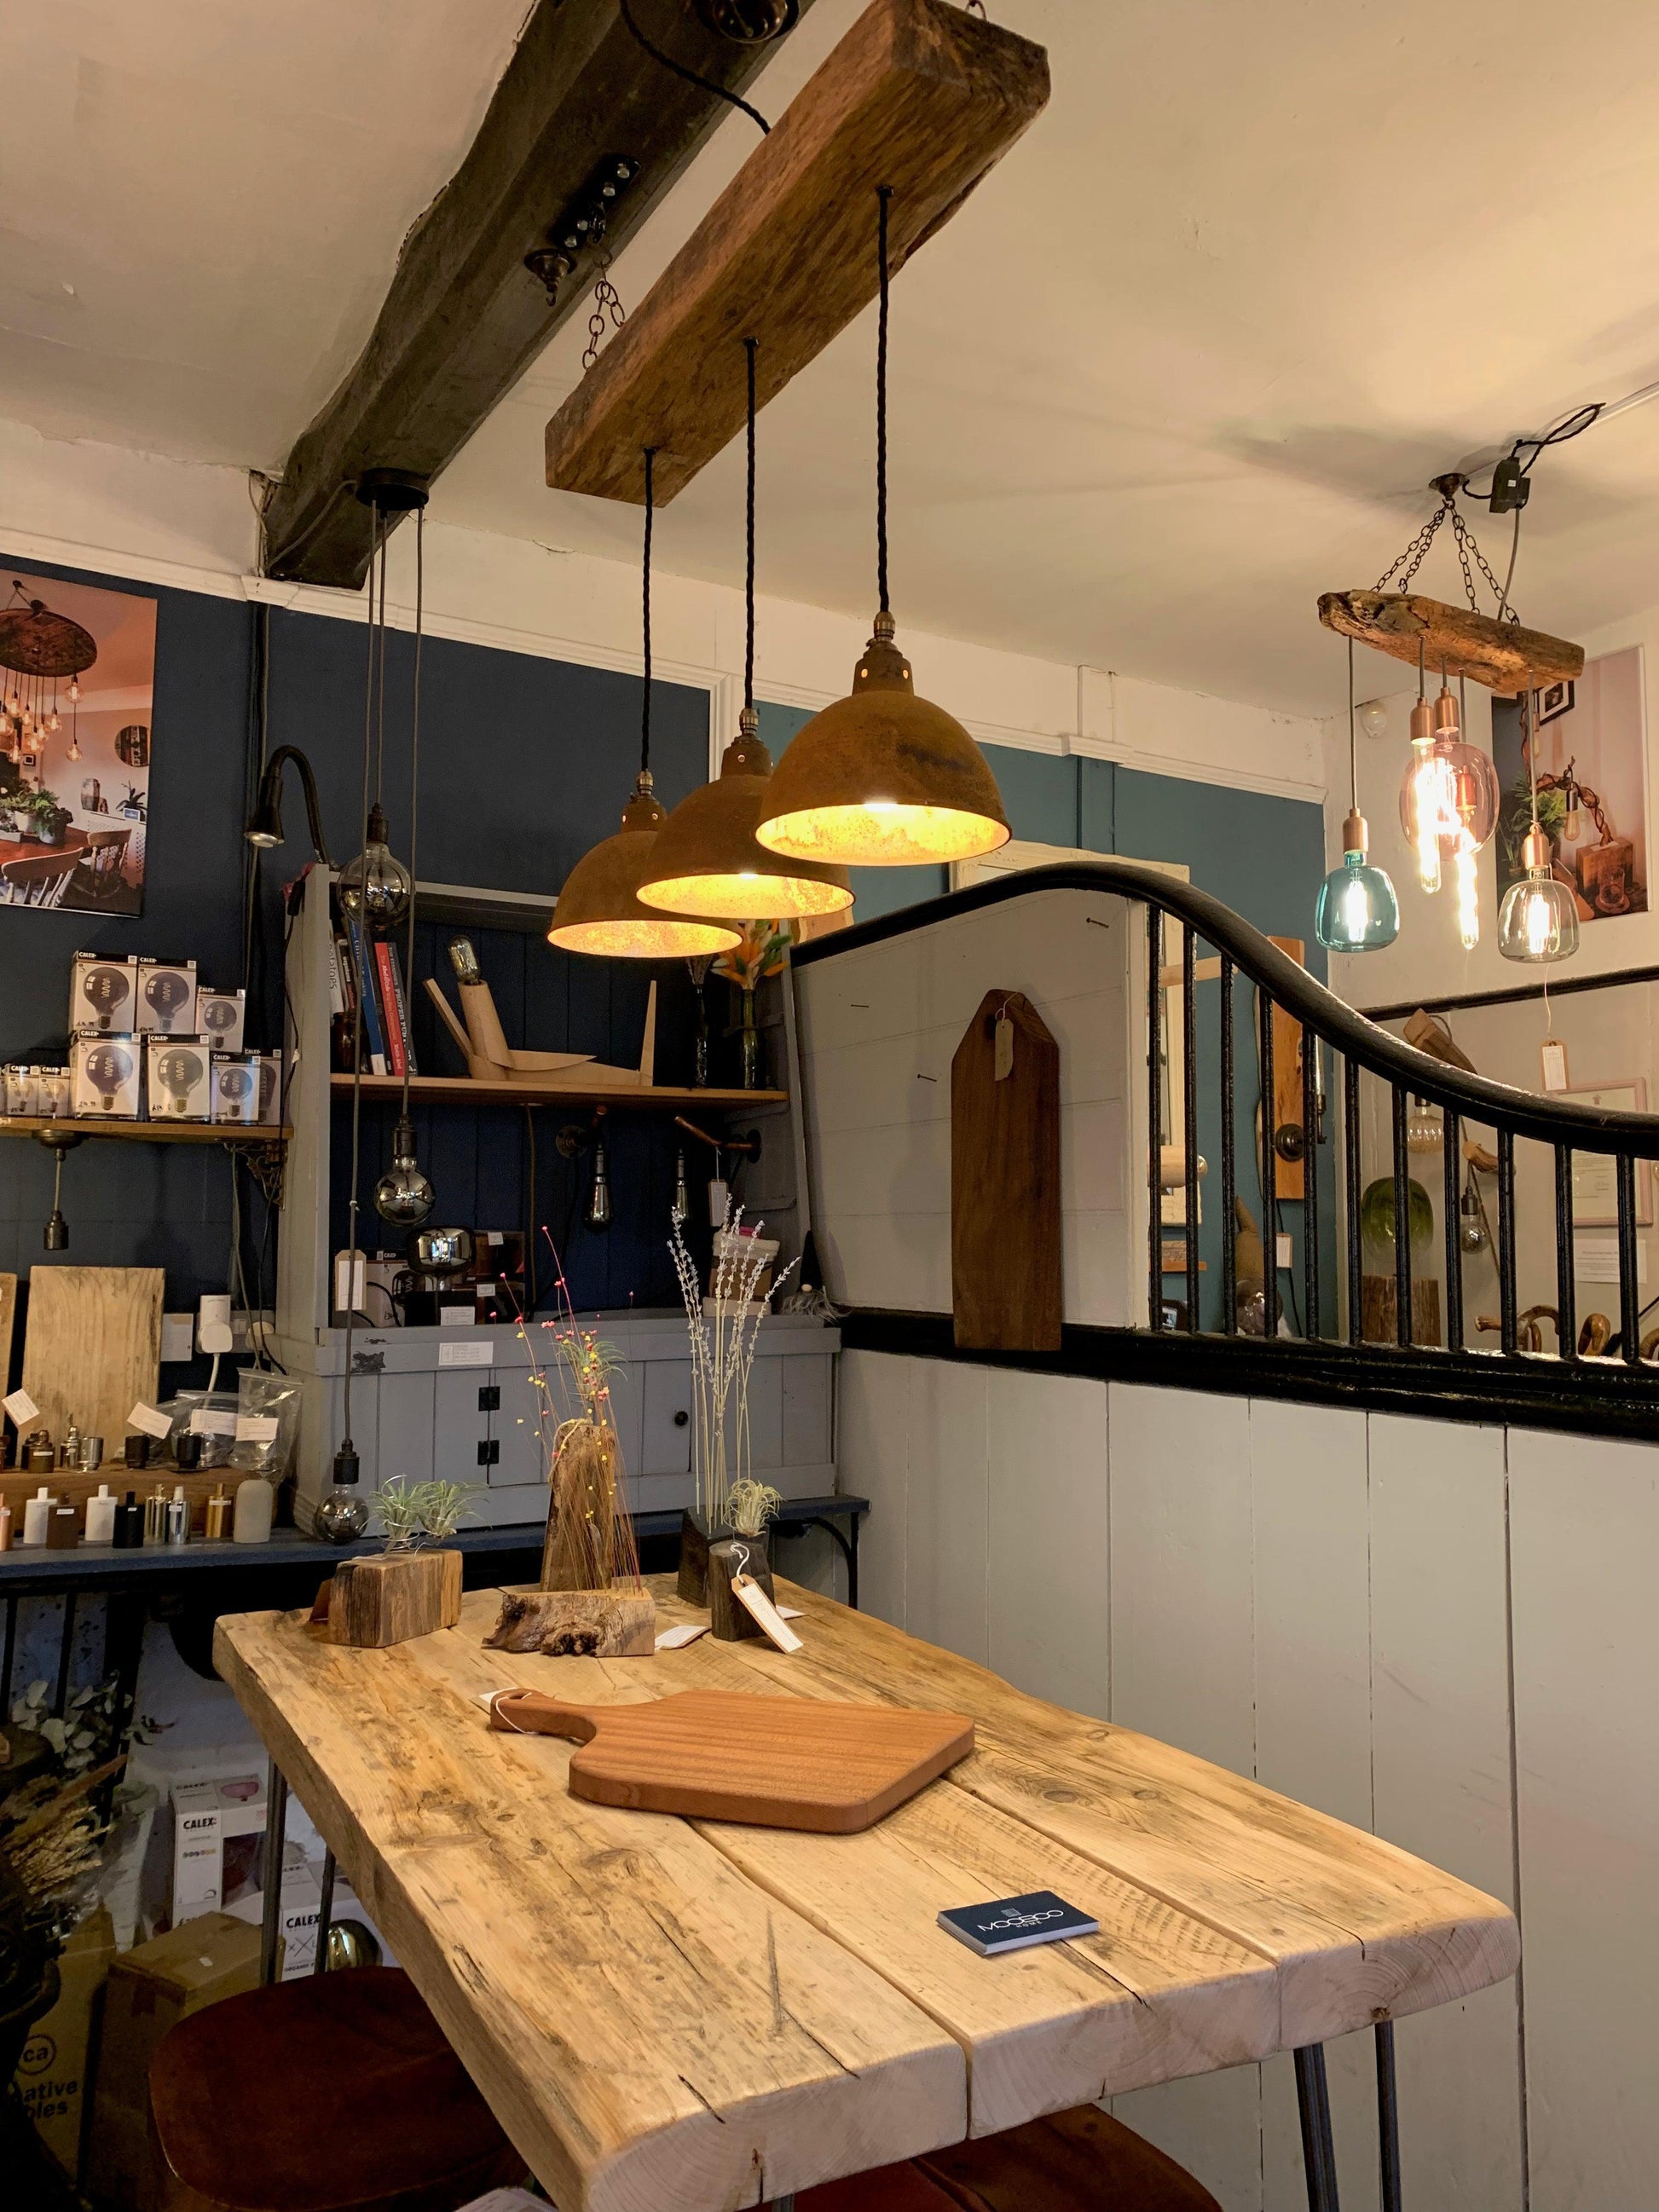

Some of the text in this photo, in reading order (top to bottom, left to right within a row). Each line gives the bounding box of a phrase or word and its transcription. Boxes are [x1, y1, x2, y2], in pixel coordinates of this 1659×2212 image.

[182, 1816, 215, 1830] CALEX
[286, 1913, 321, 1929] CALEX
[977, 1909, 1064, 1931] MOOBOO
